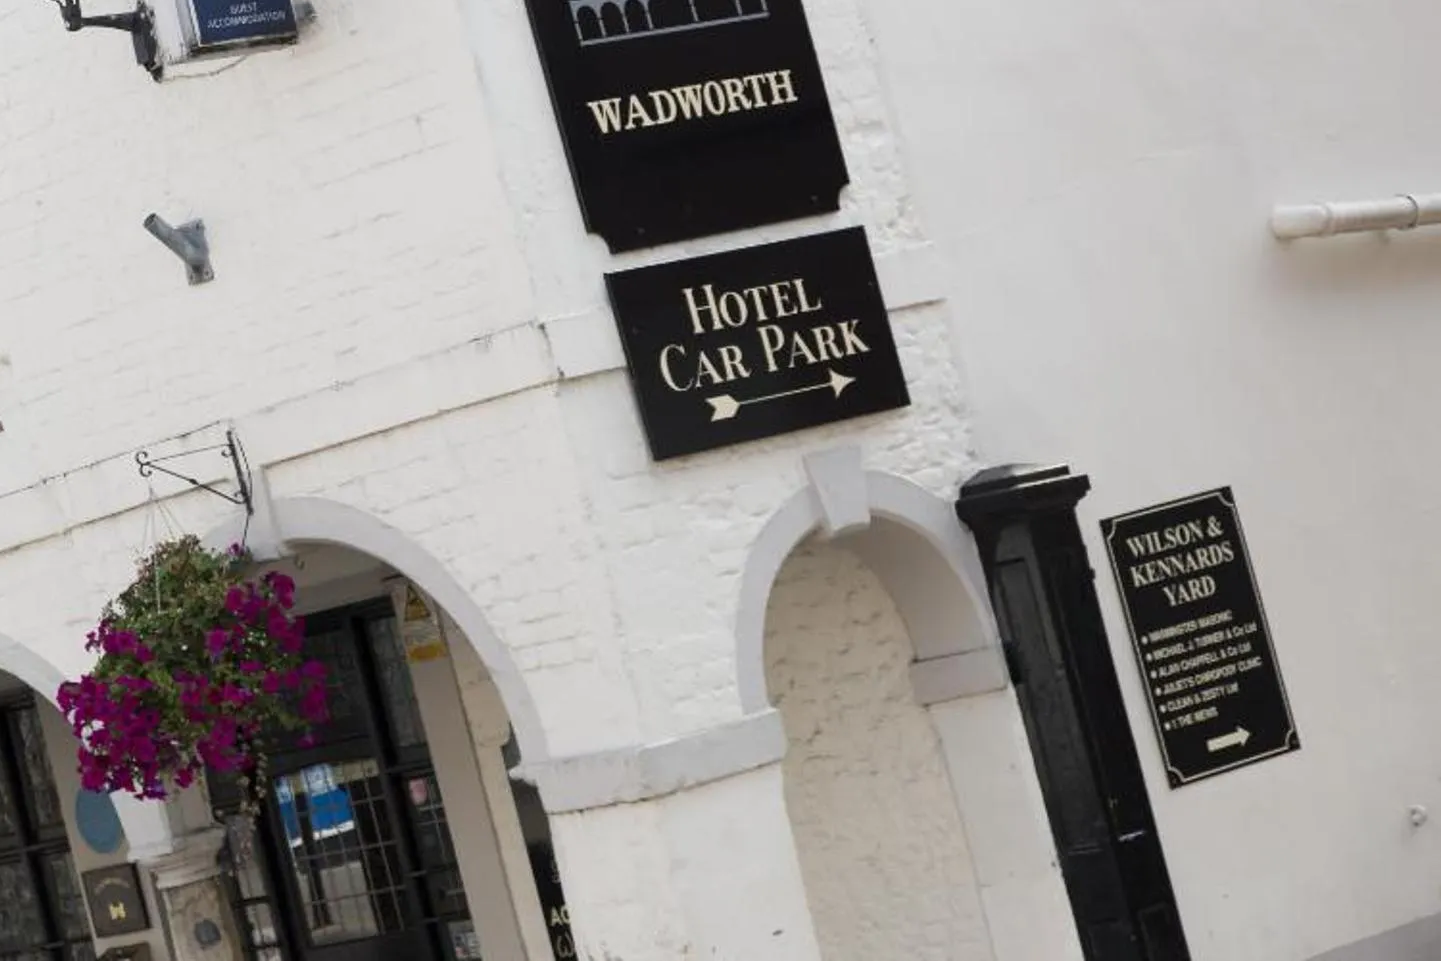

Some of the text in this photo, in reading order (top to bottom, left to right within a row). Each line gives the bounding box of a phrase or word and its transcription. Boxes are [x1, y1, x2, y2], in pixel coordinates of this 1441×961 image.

[587, 70, 798, 134] WADWORTH
[683, 279, 822, 334] HOTEL
[660, 319, 870, 392] CAR PARK
[1127, 516, 1224, 557] WILSON &
[1130, 542, 1234, 587] KENNARDS
[1163, 576, 1216, 606] YARD
